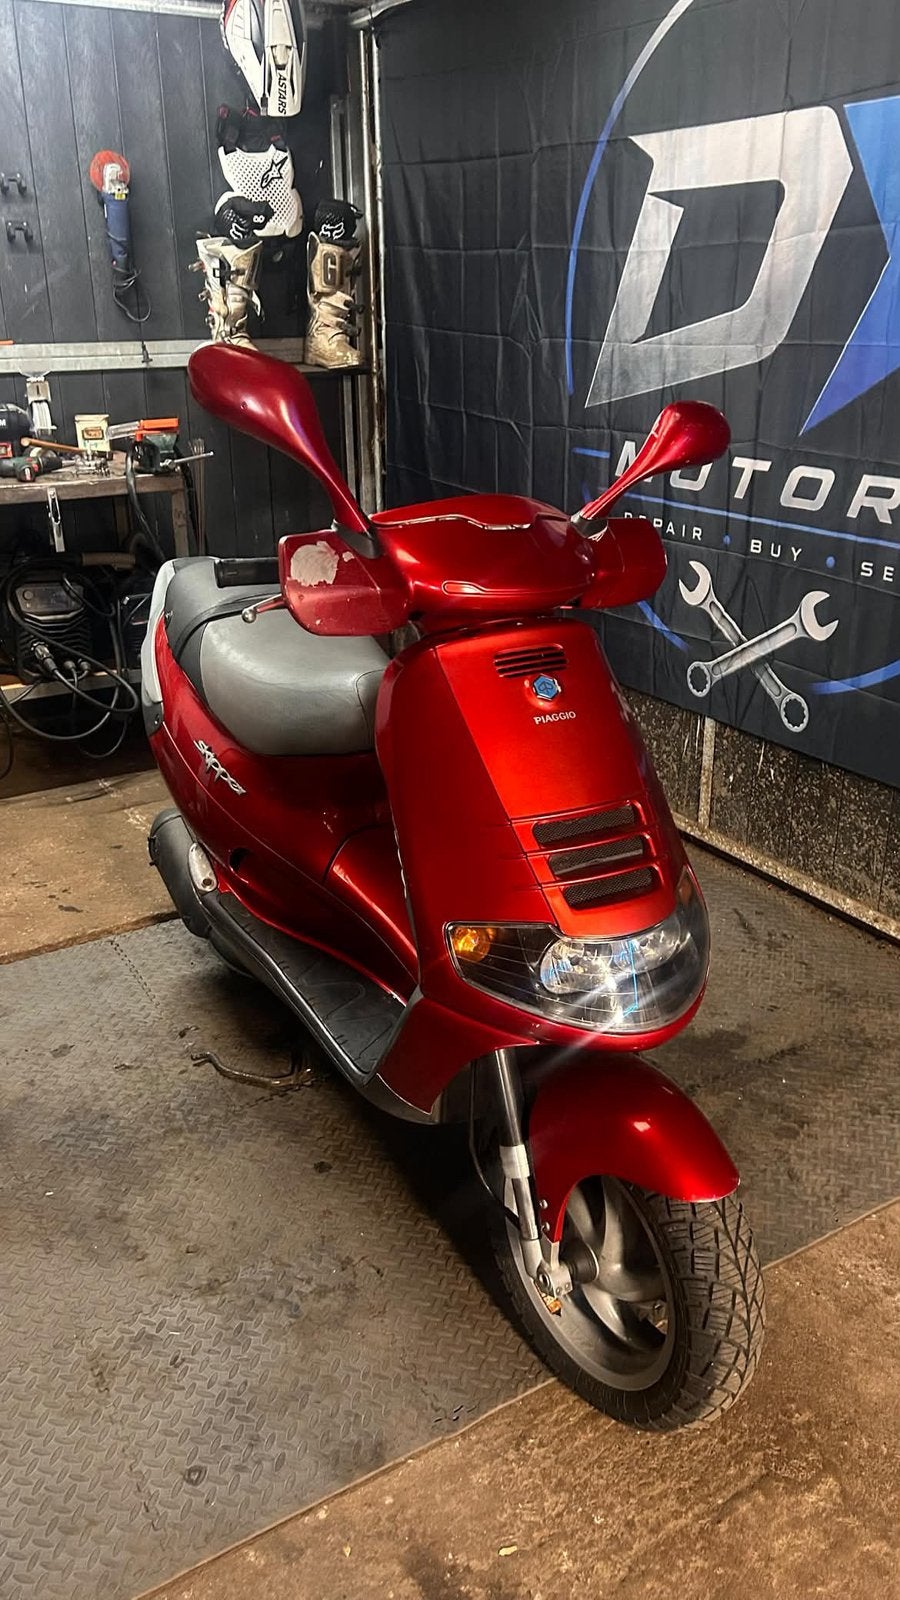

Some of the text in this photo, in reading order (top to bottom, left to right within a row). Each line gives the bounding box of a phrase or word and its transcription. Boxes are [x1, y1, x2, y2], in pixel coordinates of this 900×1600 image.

[277, 73, 287, 115] ASTARS
[624, 512, 703, 541] PAIR
[750, 539, 802, 562] BUY
[533, 711, 577, 725] PIAGGIO
